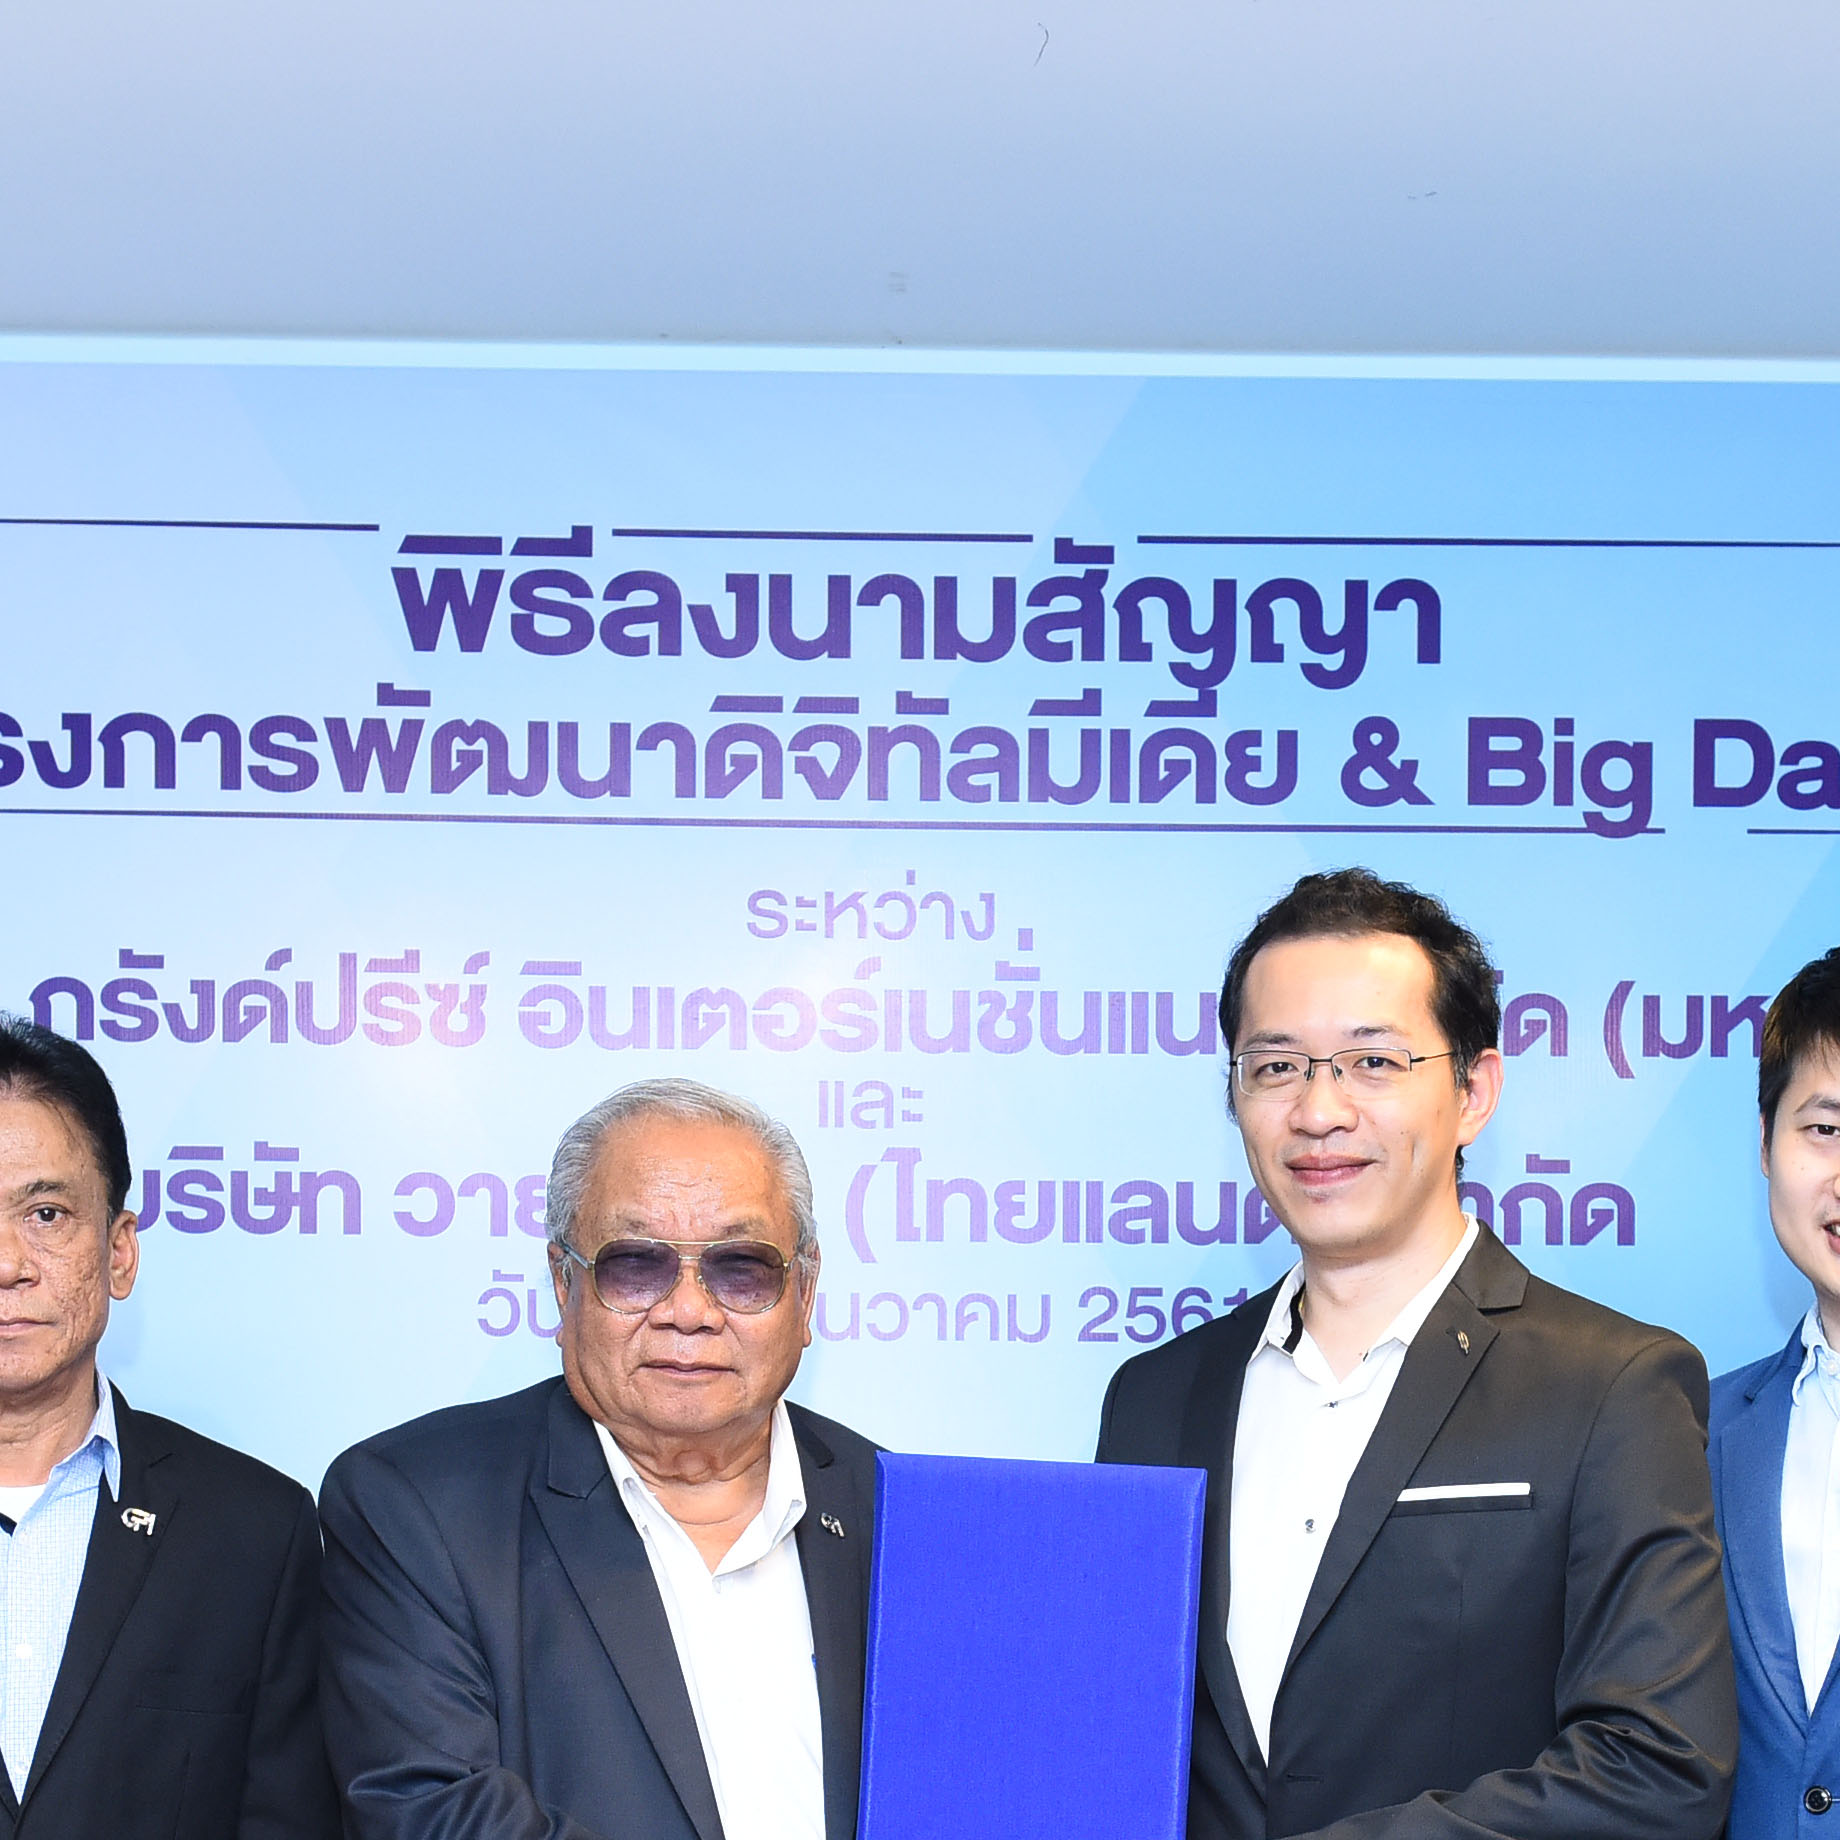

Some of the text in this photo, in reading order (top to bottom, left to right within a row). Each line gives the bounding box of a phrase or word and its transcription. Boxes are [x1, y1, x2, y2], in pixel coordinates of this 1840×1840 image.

[391, 526, 1441, 691] พิธีลงนามสัญญา
[1341, 716, 1435, 808] &
[1468, 717, 1654, 838] Big
[746, 869, 996, 941] ระหว่าง
[517, 927, 1218, 1057] อินเตอร์เนชั่นแน
[817, 1079, 924, 1130] และ
[816, 1291, 1052, 1344] นวาคม
